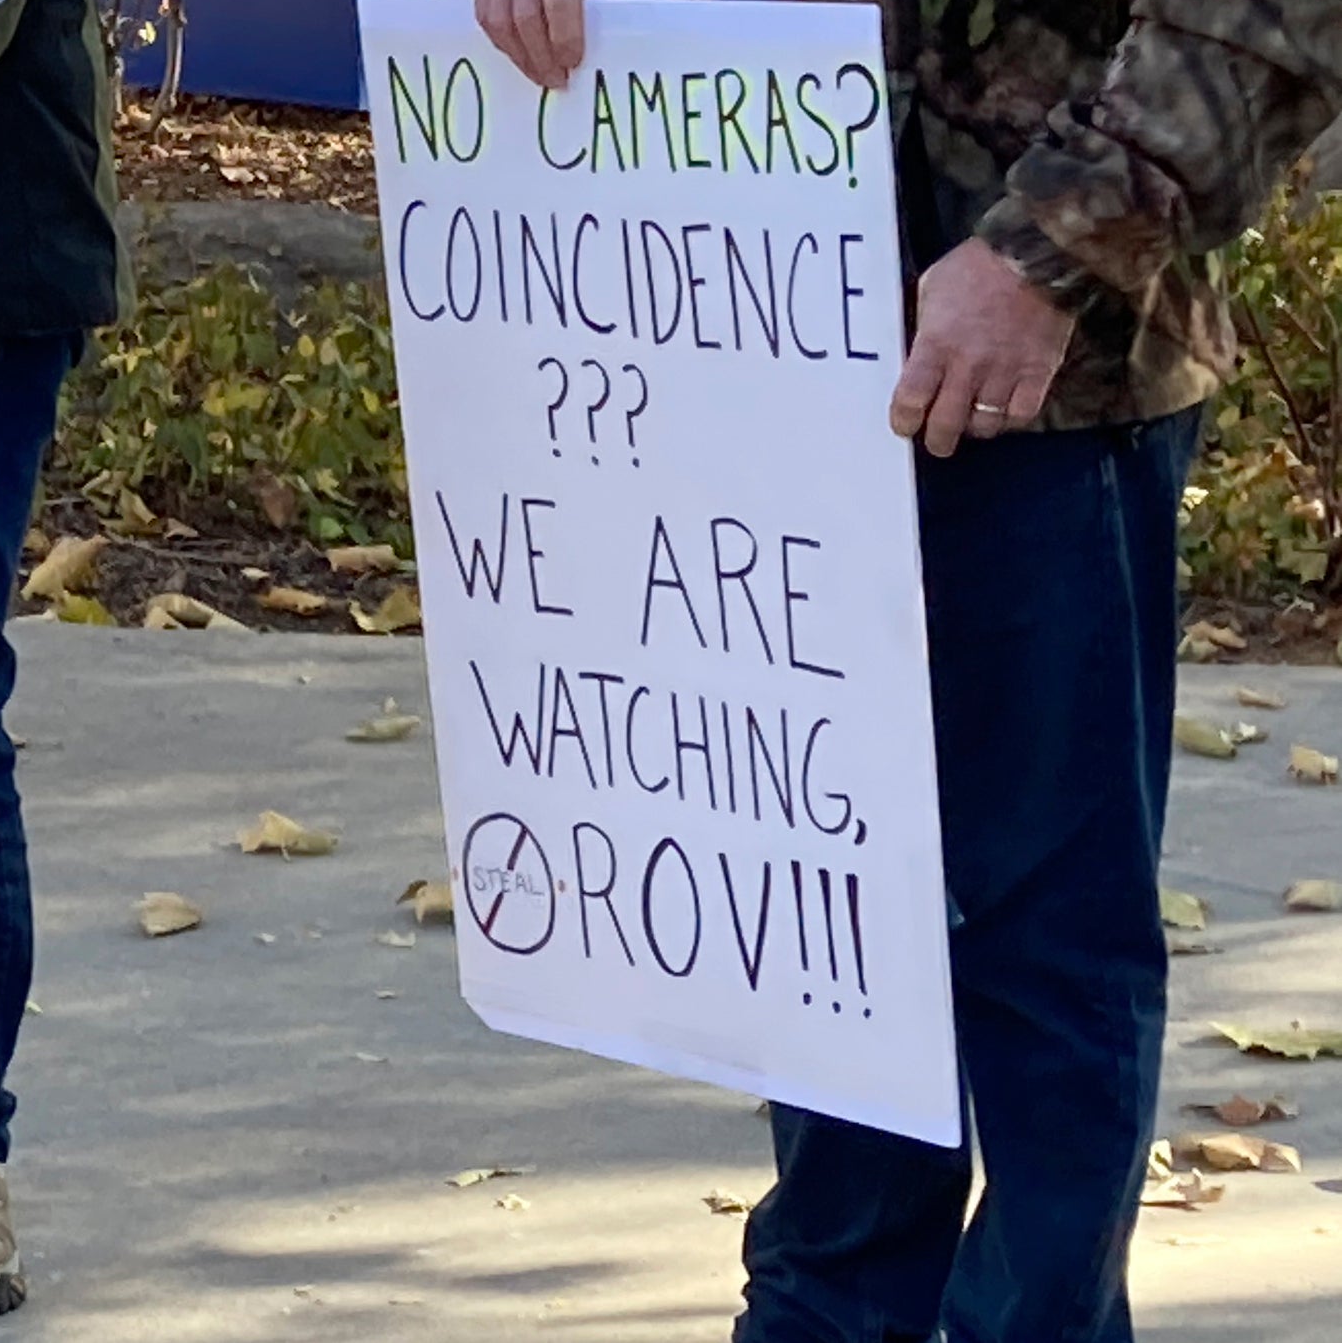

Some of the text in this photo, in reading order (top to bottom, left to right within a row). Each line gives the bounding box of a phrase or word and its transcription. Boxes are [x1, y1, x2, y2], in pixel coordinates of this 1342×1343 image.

[388, 55, 881, 189] NO CAMERAS?
[398, 199, 880, 361] COINCIDENCE
[537, 357, 649, 469] ???
[435, 490, 845, 679] WE ARE
[469, 659, 867, 846] WATCHING,
[572, 821, 872, 1019] ROV!!!
